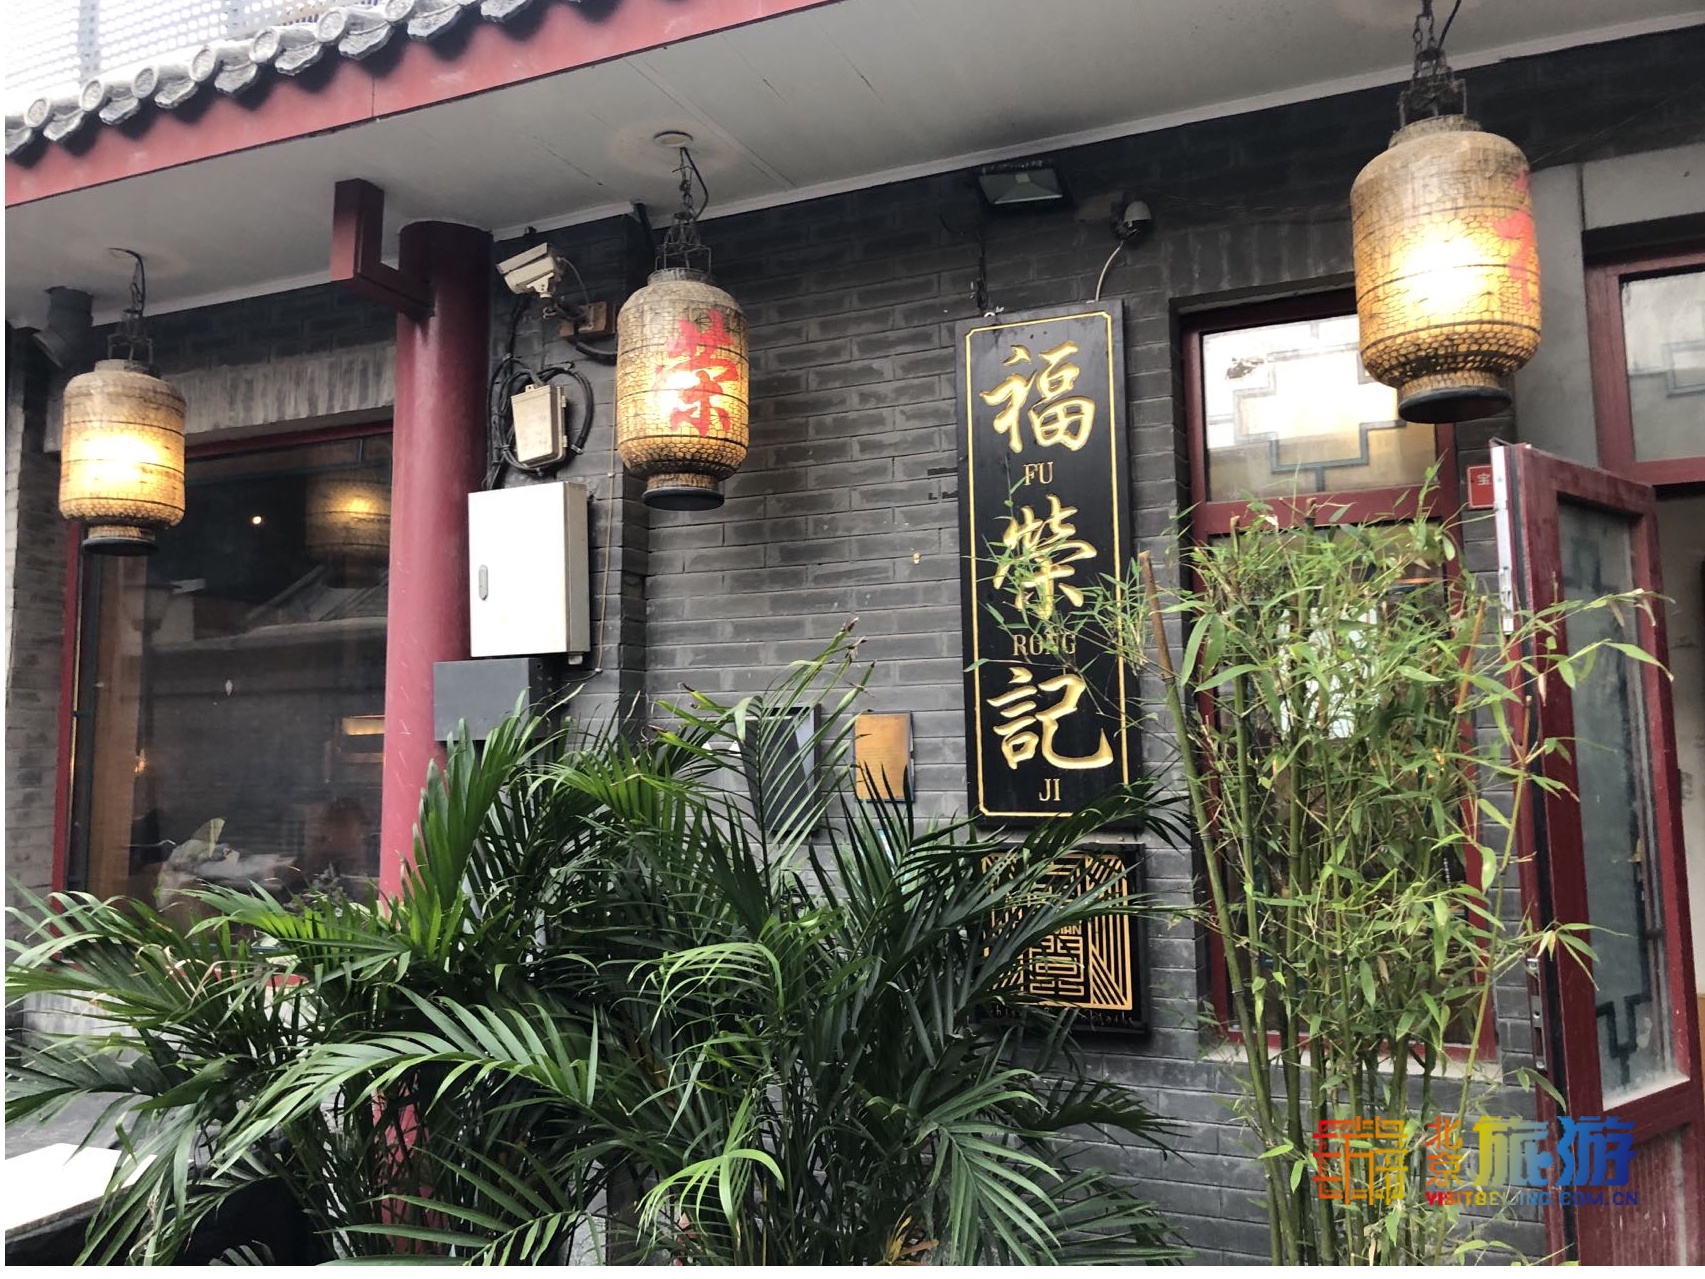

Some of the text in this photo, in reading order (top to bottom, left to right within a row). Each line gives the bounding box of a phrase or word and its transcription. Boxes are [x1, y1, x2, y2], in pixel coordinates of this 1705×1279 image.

[980, 340, 1096, 453] 福
[1023, 461, 1054, 486] FU
[993, 494, 1098, 620] 榮
[987, 666, 1114, 770] 記
[1038, 778, 1061, 801] JI
